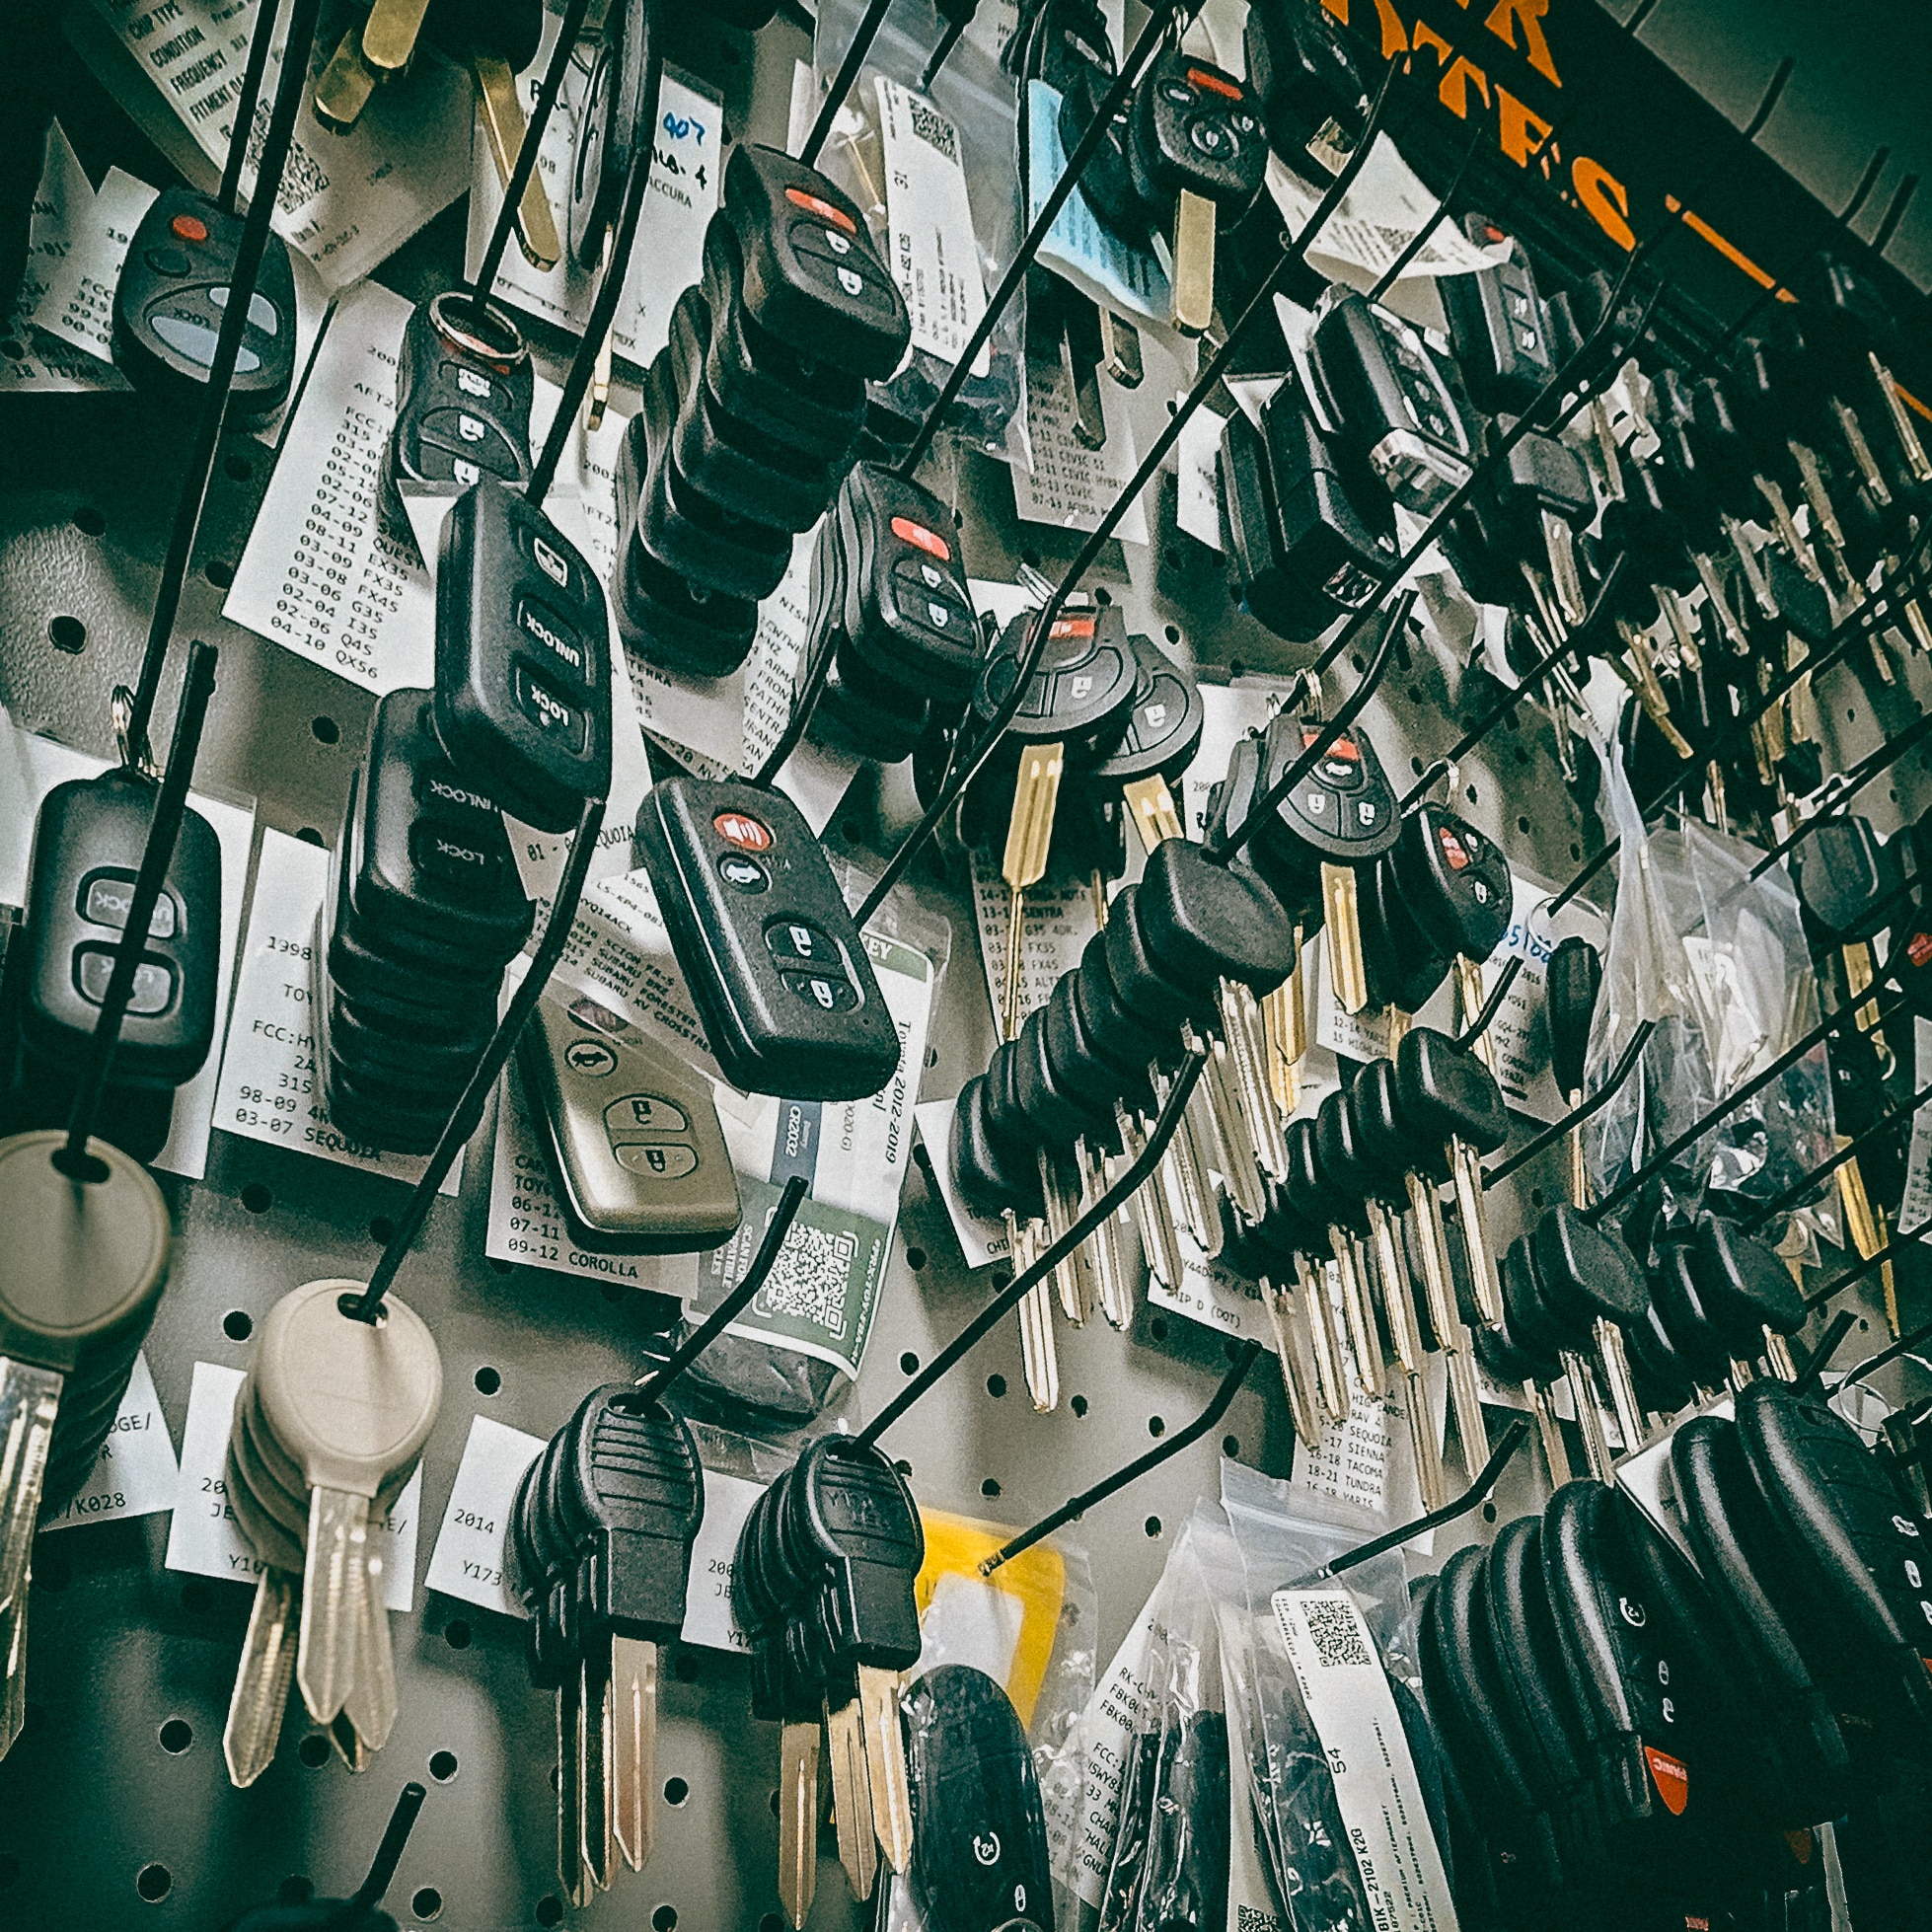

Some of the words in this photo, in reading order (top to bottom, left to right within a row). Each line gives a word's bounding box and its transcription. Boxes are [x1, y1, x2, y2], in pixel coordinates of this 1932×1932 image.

[149, 25, 205, 68] CONDITION
[170, 49, 227, 95] FREQUENCY
[188, 84, 234, 123] FITMENT
[311, 503, 363, 537] 04-09
[316, 488, 368, 524] 07-12
[305, 519, 356, 554] 08-11
[294, 551, 346, 585] 03-08
[363, 568, 403, 596] FX35
[300, 535, 352, 568] 03-09
[368, 554, 409, 581] EX35
[282, 583, 335, 618] 02-04
[351, 600, 383, 624] G35
[288, 566, 341, 601] 03-06
[358, 584, 398, 613] FX45
[271, 616, 326, 651] 04-10
[341, 633, 372, 656] Q45
[276, 600, 331, 634] 02-06
[346, 618, 377, 639] I35
[526, 611, 580, 668] UNLOCK
[335, 650, 378, 679] QX56
[531, 684, 569, 727] LOCK
[437, 839, 484, 865] LOCK
[596, 826, 635, 850] QUOIA
[267, 936, 312, 961] 1998
[598, 948, 641, 979] SUBARU
[864, 937, 893, 960] EY
[585, 967, 629, 998] SUBARU
[591, 958, 634, 989] SUBARU
[639, 988, 697, 1028] FORESTER
[240, 1086, 296, 1112] 98-09
[278, 1074, 313, 1094] 315
[236, 1108, 293, 1134] 03-07
[784, 1106, 801, 1157] CR2032
[886, 1078, 906, 1163] 2012-2019
[510, 1218, 558, 1240] 07-11
[740, 1224, 753, 1254] SCAN
[509, 1238, 558, 1261] 09-12
[568, 1252, 638, 1279] COROLLA
[1211, 1304, 1241, 1329] (DOT)
[1348, 1443, 1385, 1462] SIENNA
[1350, 1426, 1392, 1448] SEQUOIA
[1307, 1464, 1338, 1483] 18-21
[1346, 1475, 1381, 1495] TUNDRA
[1347, 1459, 1383, 1478] TACOMA
[454, 1509, 495, 1534] 2014
[463, 1561, 503, 1587] Y173
[1100, 1700, 1134, 1734] FBK00
[1328, 1748, 1346, 1773] 54
[1381, 1805, 1402, 1864] AFTERMARKET
[1361, 1860, 1378, 1892] 2102
[1399, 1869, 1413, 1908] PREMIUM
